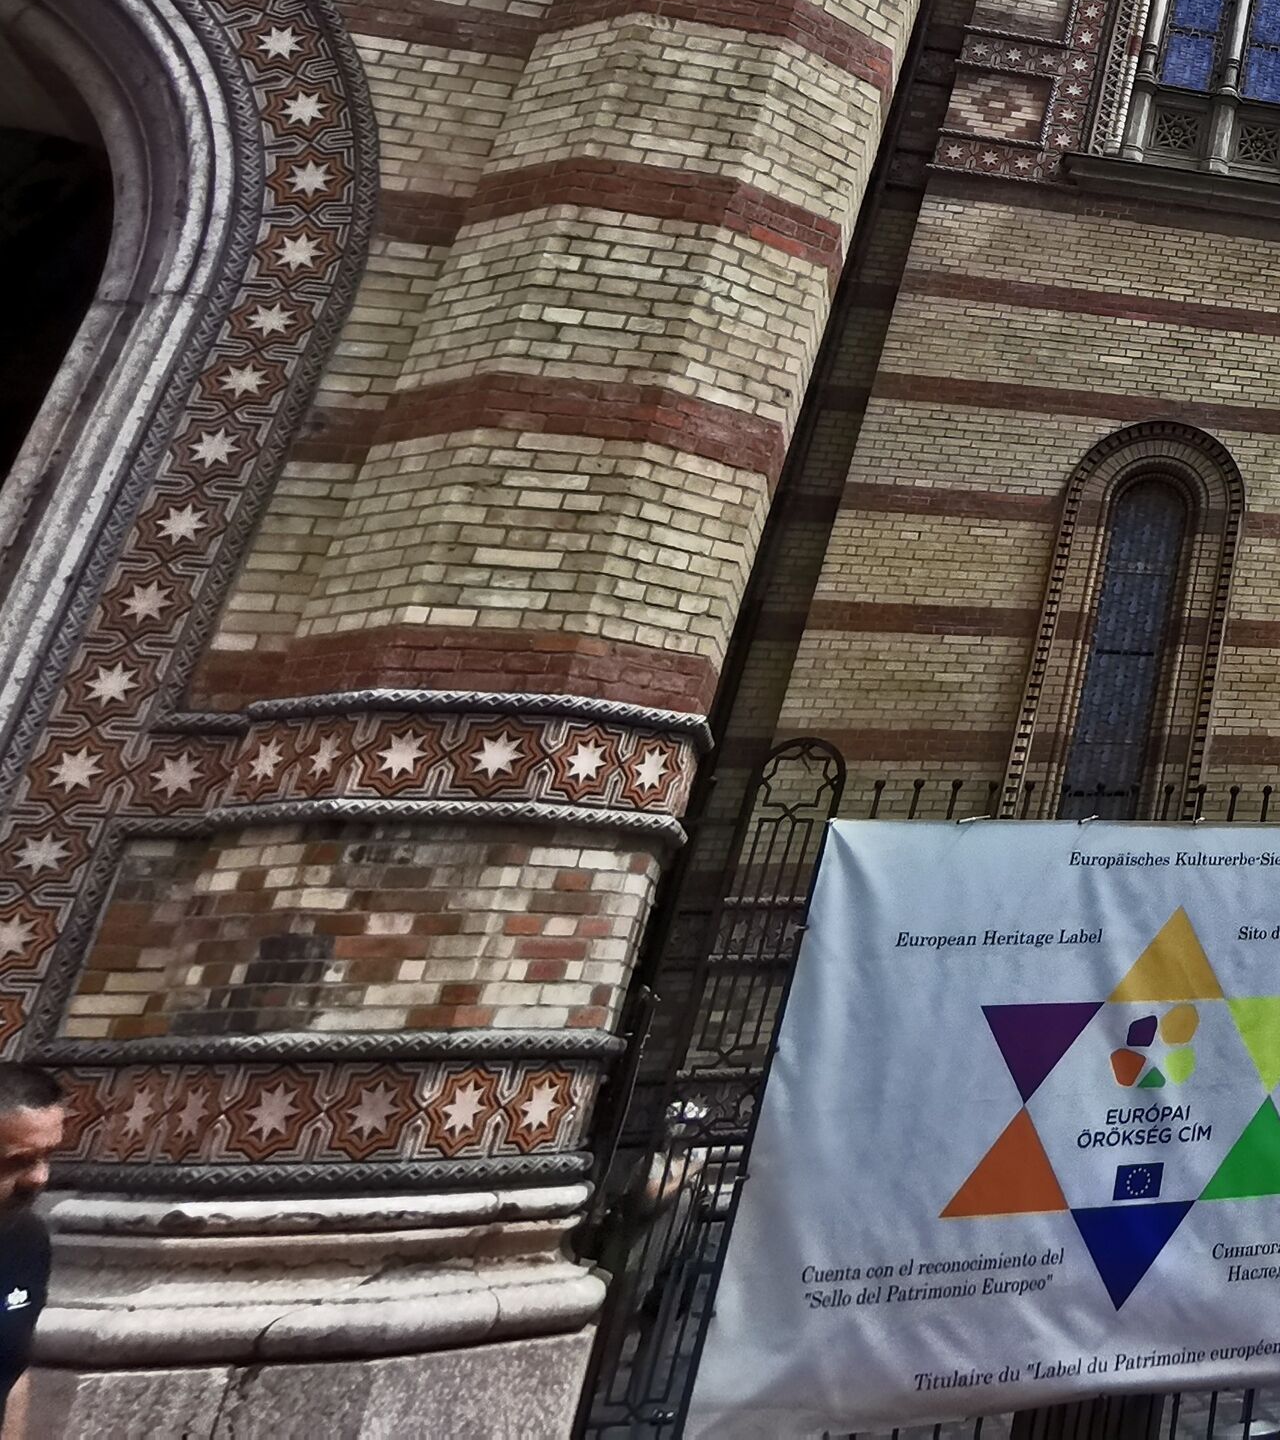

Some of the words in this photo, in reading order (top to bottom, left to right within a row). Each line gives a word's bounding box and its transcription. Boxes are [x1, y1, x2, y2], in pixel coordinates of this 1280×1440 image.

[1069, 852, 1170, 869] Europäisches
[895, 931, 977, 949] European
[982, 930, 1054, 948] Heritage
[1057, 928, 1103, 944] Label
[1237, 925, 1267, 940] Sito
[1106, 1103, 1191, 1125] EURÓPAI
[1077, 1125, 1172, 1149] ÖRÖKSÉG
[1178, 1122, 1212, 1142] CÍM
[801, 1265, 861, 1284] Cuenta
[866, 1266, 894, 1279] con
[900, 1259, 914, 1277] el
[918, 1252, 1037, 1275] reconocimiento
[1041, 1247, 1065, 1266] del
[804, 1290, 852, 1309] "Sello
[856, 1286, 881, 1305] del
[886, 1282, 977, 1303] Patrimonio
[982, 1273, 1053, 1296] Europeo"
[914, 1367, 993, 1392] Titulaire
[998, 1365, 1021, 1384] du
[1026, 1357, 1082, 1381] "Label
[1086, 1356, 1108, 1374] du
[1113, 1348, 1206, 1372] Patrimoine
